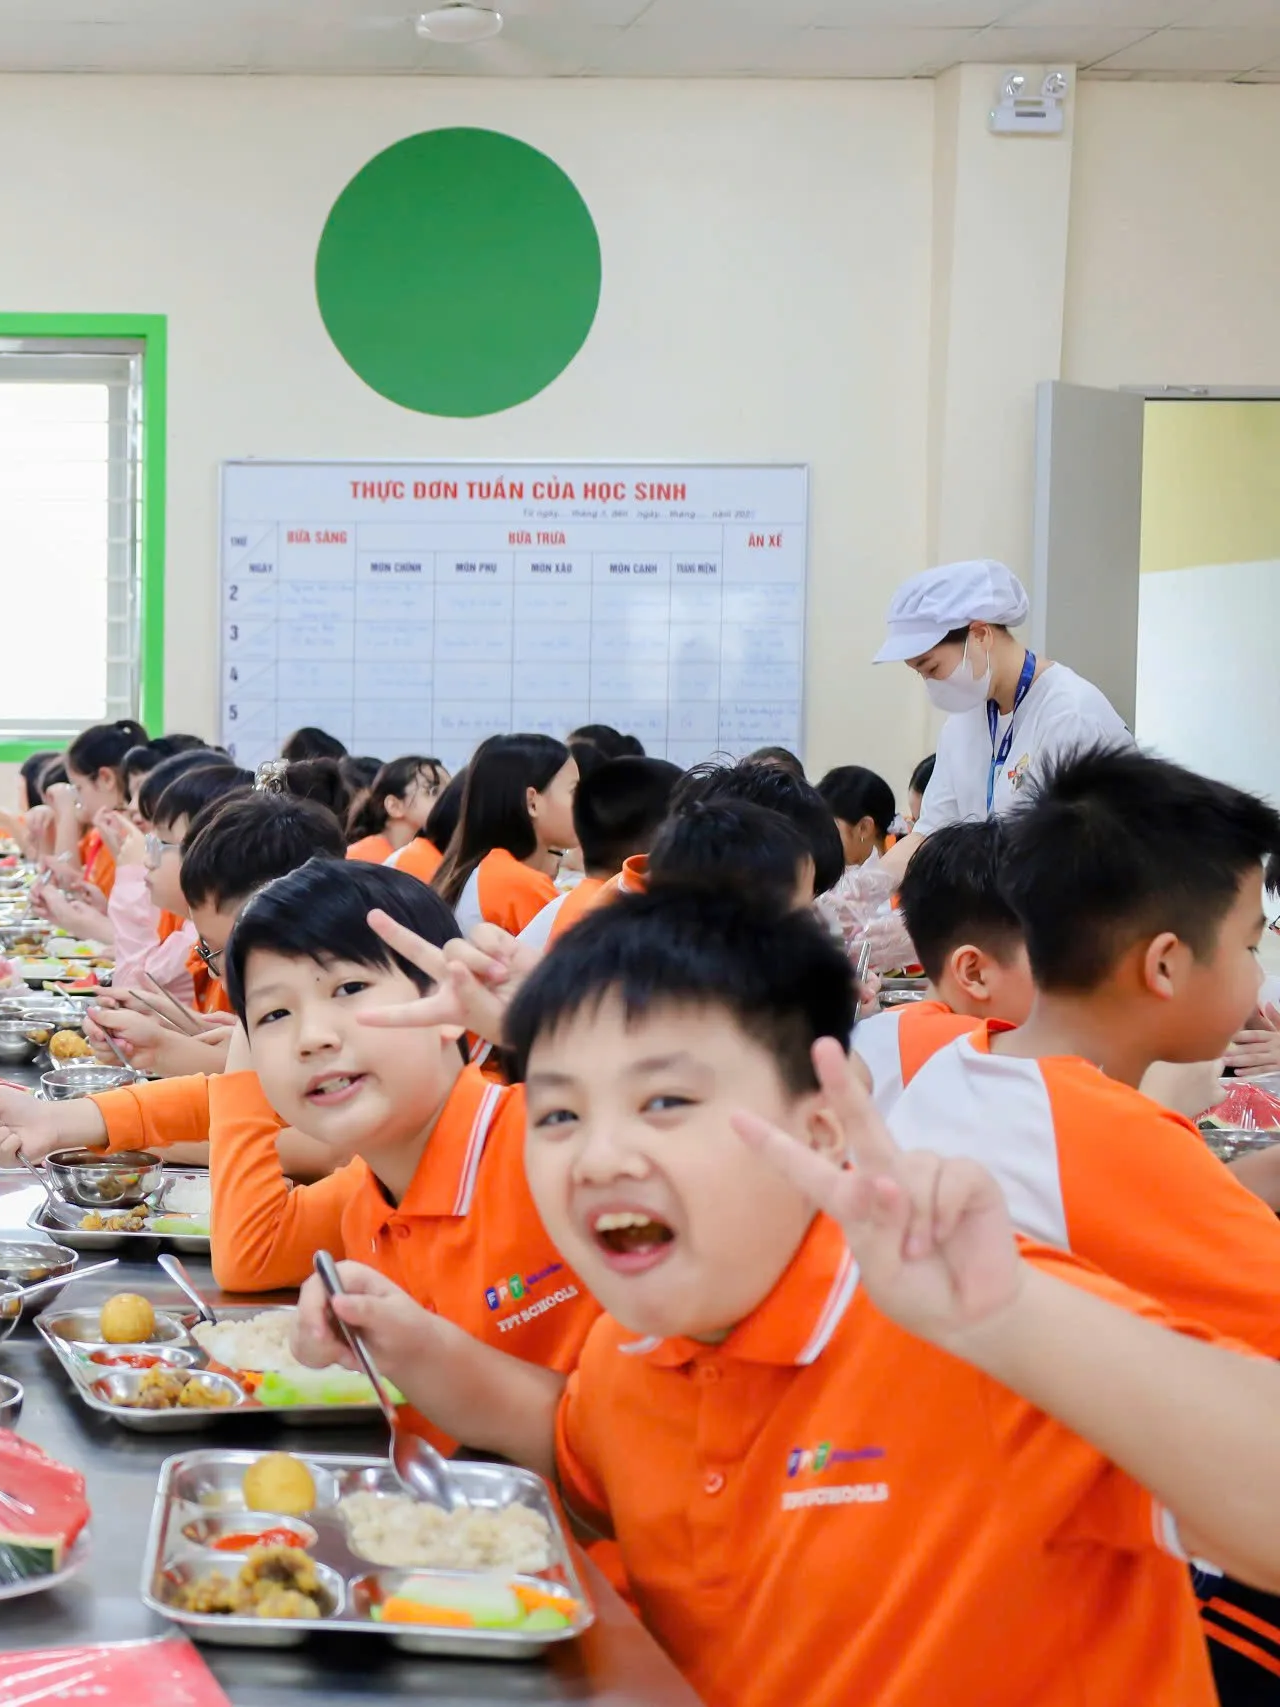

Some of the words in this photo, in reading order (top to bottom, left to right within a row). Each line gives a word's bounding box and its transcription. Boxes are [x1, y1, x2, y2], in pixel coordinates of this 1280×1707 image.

[350, 480, 406, 503] THỰC
[532, 475, 576, 499] CỦA
[583, 481, 626, 504] HỌC
[634, 482, 687, 500] SINH
[229, 585, 238, 601] 2
[229, 625, 239, 641] 3
[229, 667, 238, 682] 4
[228, 705, 238, 721] 5
[485, 1274, 524, 1311] FPT
